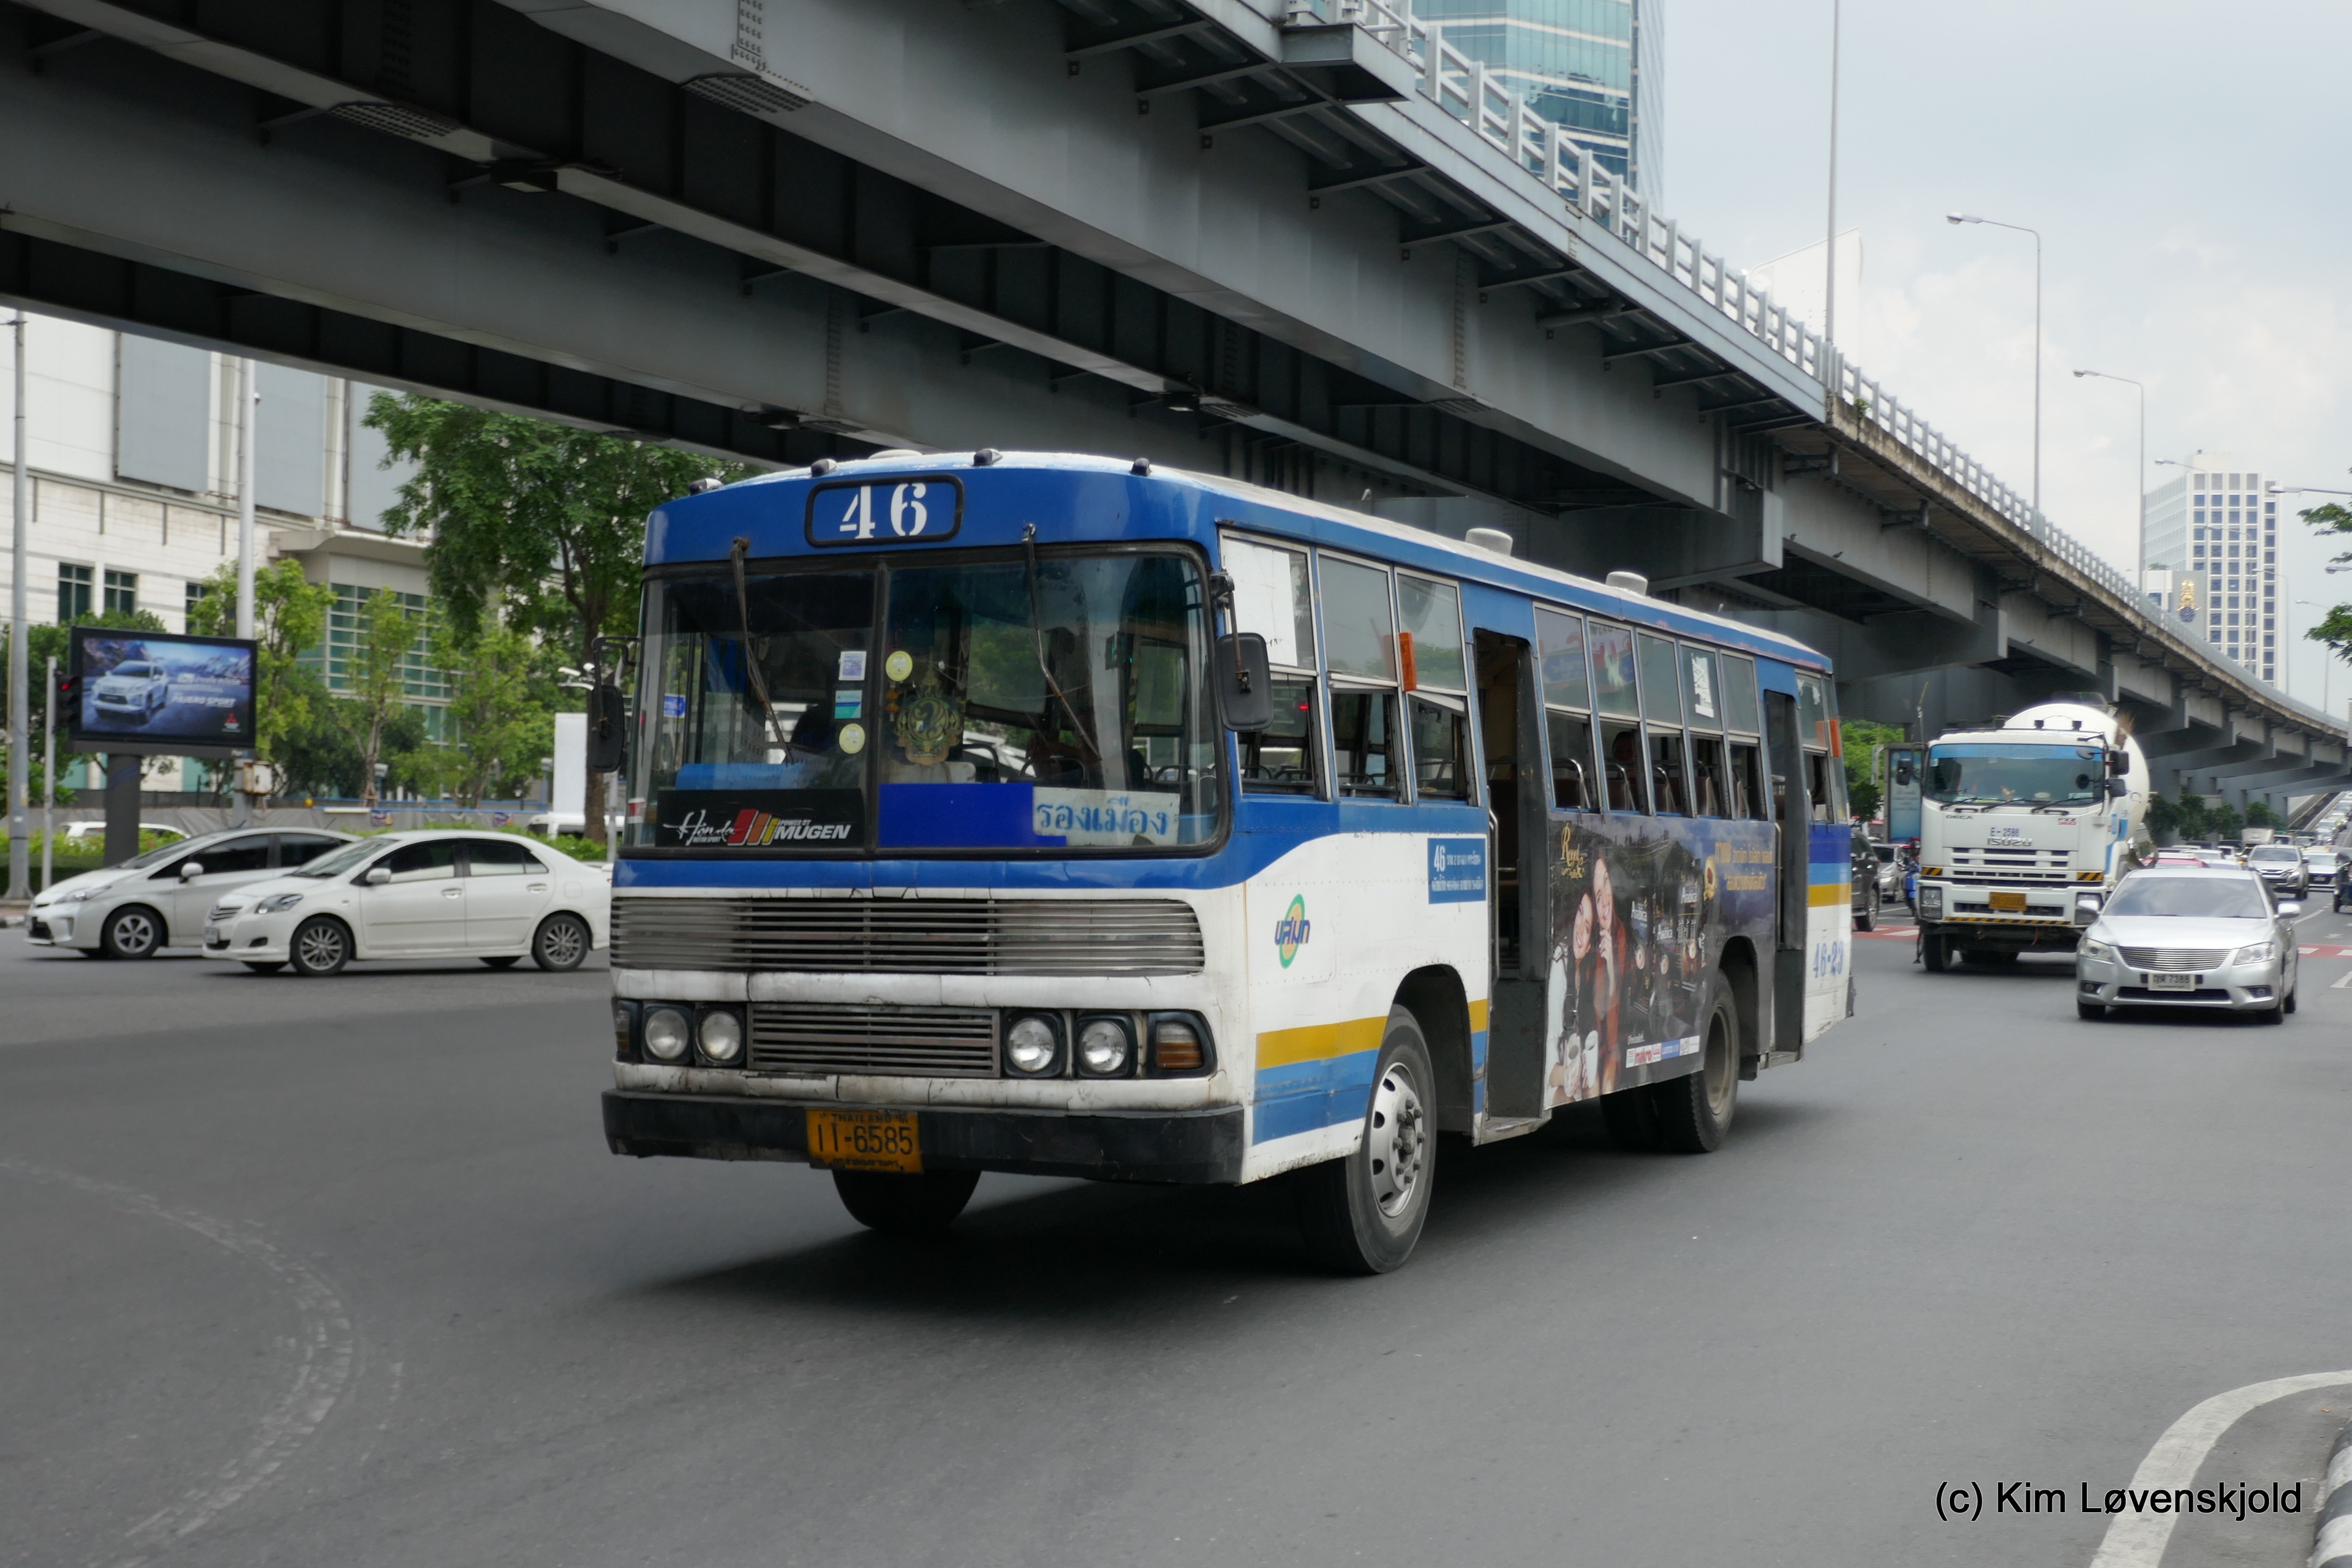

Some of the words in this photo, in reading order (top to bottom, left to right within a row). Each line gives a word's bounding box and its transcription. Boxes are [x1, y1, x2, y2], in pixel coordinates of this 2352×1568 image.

[840, 483, 928, 539] 46
[663, 809, 735, 846] Honda
[774, 824, 851, 840] MUGEN
[1036, 796, 1169, 836] รองเมือง
[1987, 837, 2033, 846] ISUZU
[1434, 845, 1446, 872] 46
[1813, 941, 1844, 978] 46-23
[832, 1112, 892, 1123] THAILAND
[818, 1123, 913, 1155] 11-6585
